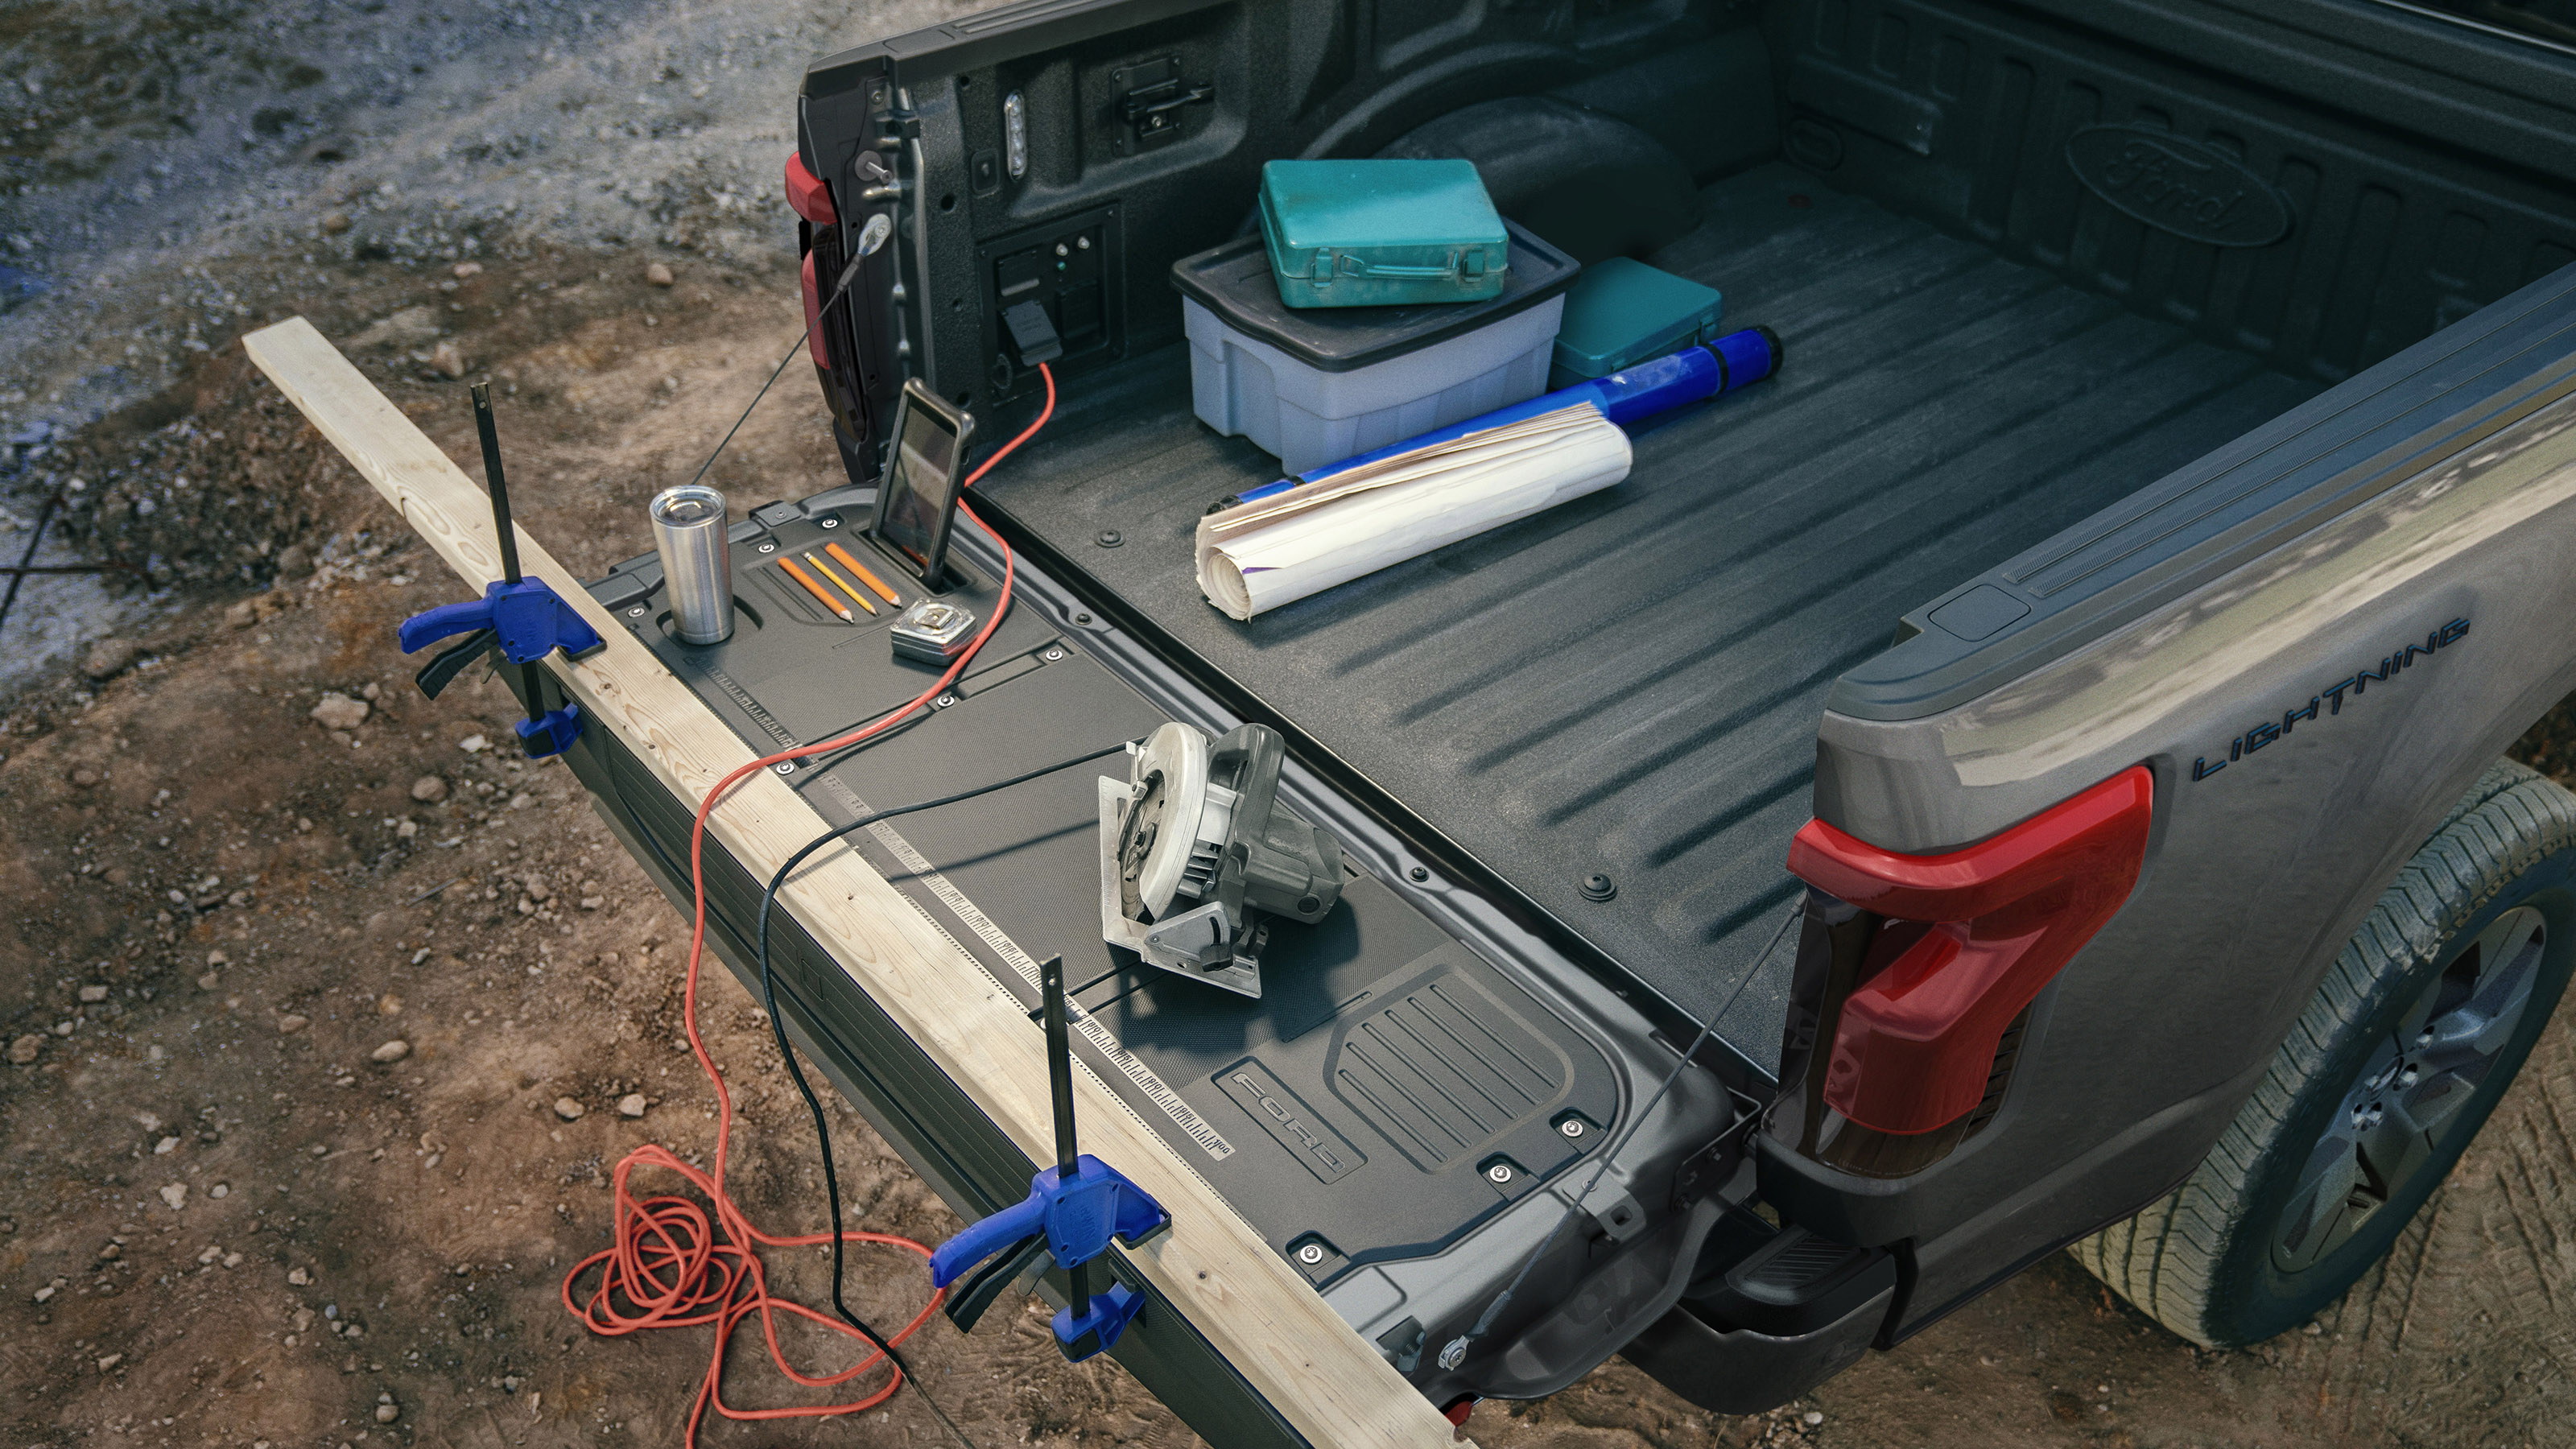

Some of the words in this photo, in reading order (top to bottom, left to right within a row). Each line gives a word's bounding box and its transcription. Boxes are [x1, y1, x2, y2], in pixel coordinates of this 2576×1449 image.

[2105, 138, 2243, 229] Ford
[2192, 617, 2471, 782] LIGHTNING
[1212, 1138, 1231, 1154] 100
[1230, 1072, 1345, 1174] FORD
